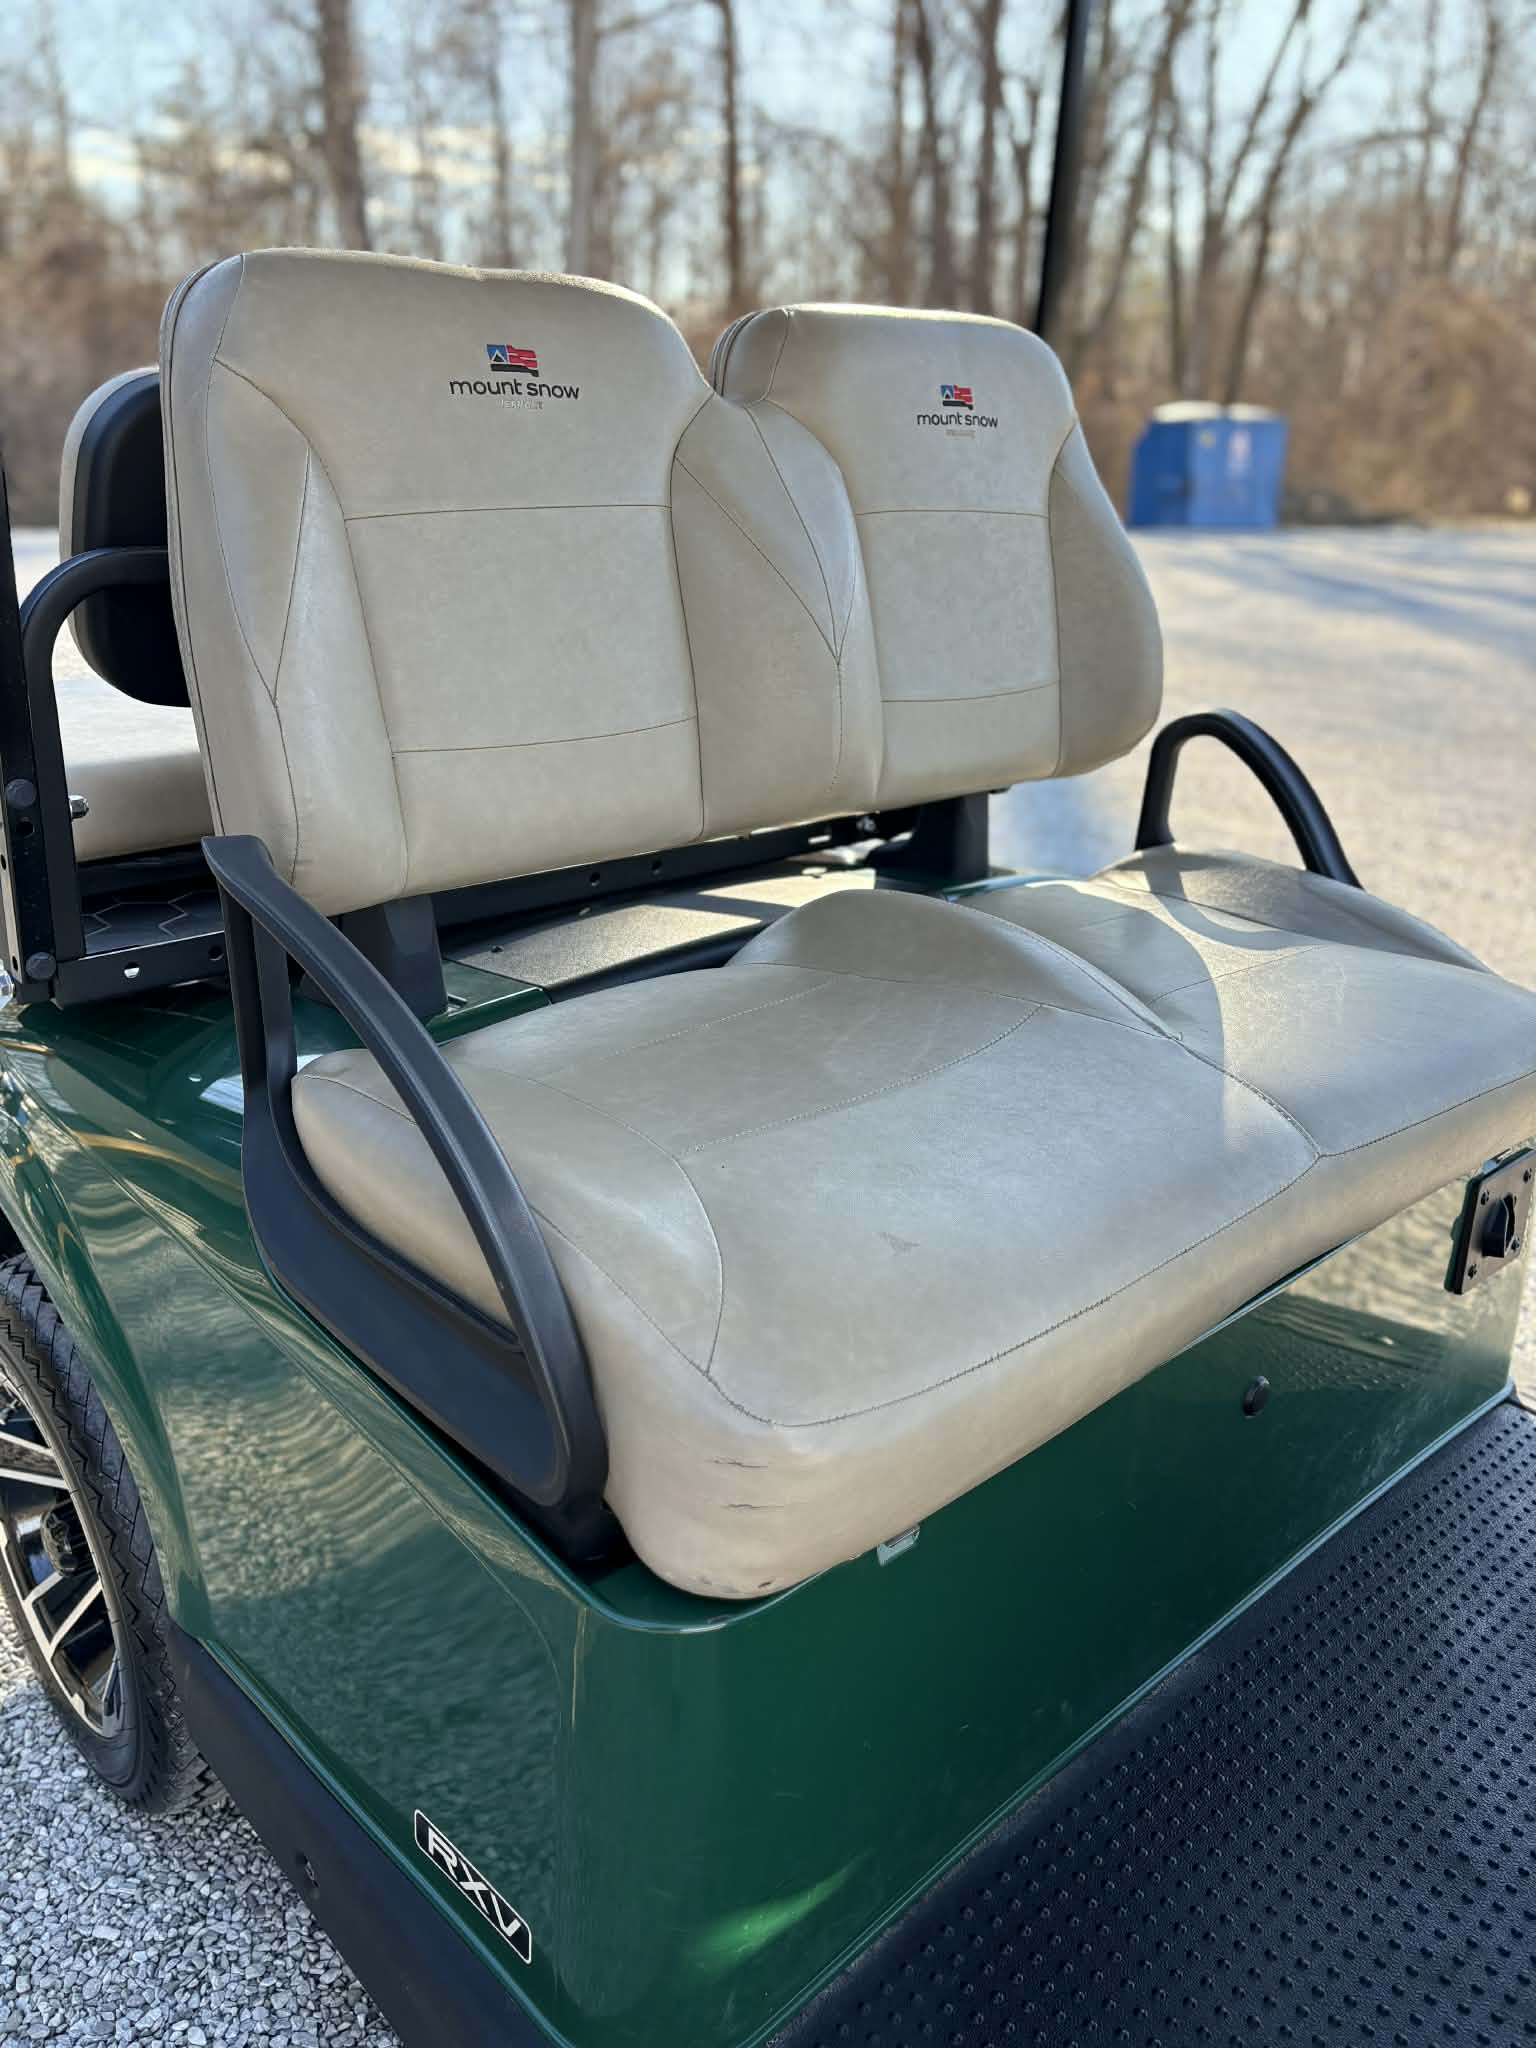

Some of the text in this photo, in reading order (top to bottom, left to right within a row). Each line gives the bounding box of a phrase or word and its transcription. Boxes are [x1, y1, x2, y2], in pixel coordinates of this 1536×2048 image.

[449, 379, 580, 399] mount snow
[916, 412, 998, 428] mount snow
[428, 1826, 521, 1937] RXV
